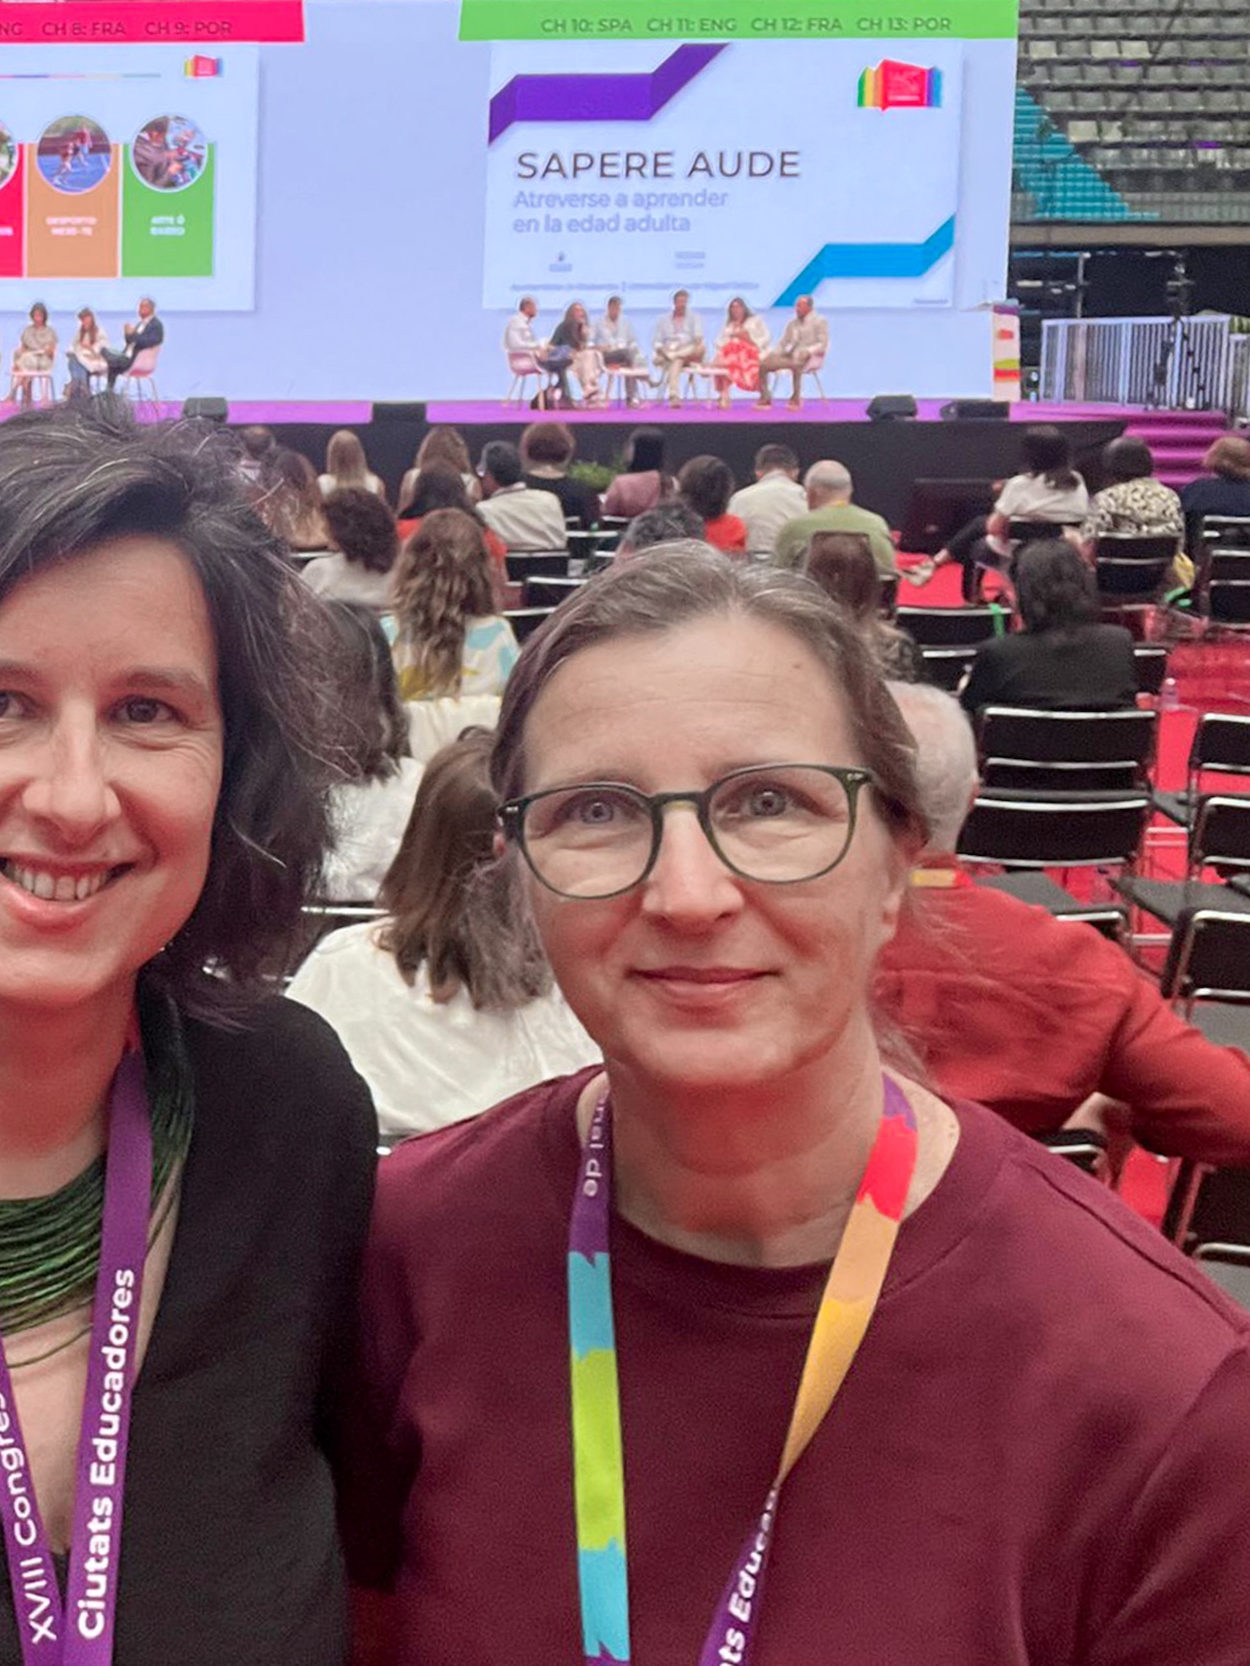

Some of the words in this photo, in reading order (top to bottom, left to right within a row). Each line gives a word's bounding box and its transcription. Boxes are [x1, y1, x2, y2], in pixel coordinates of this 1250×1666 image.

[42, 22, 66, 36] CH
[72, 22, 86, 36] 8:
[91, 22, 126, 36] FRA
[145, 22, 169, 36] CH
[175, 22, 190, 36] 9:
[195, 22, 232, 36] POR
[541, 18, 566, 32] CH
[571, 18, 593, 32] 10:
[599, 18, 633, 32] SPA
[647, 18, 672, 32] CH
[677, 18, 695, 32] 11:
[700, 18, 737, 32] ENG
[751, 18, 777, 32] CH
[782, 18, 802, 32] 12:
[808, 18, 843, 32] FRA
[856, 18, 882, 32] CH
[888, 18, 908, 32] 13:
[913, 18, 951, 32] POR
[517, 151, 673, 179] SAPERE
[688, 151, 800, 178] AUDE
[513, 190, 611, 209] Atreverse
[614, 194, 628, 208] a
[633, 189, 728, 211] aprender
[513, 217, 540, 233] en
[545, 215, 562, 233] la
[567, 215, 619, 233] edad
[625, 214, 691, 232] adulta
[89, 1269, 135, 1486] Educadores
[77, 1496, 114, 1640] Ciutats
[19, 1557, 58, 1644] XVIII
[717, 1627, 746, 1666] ts
